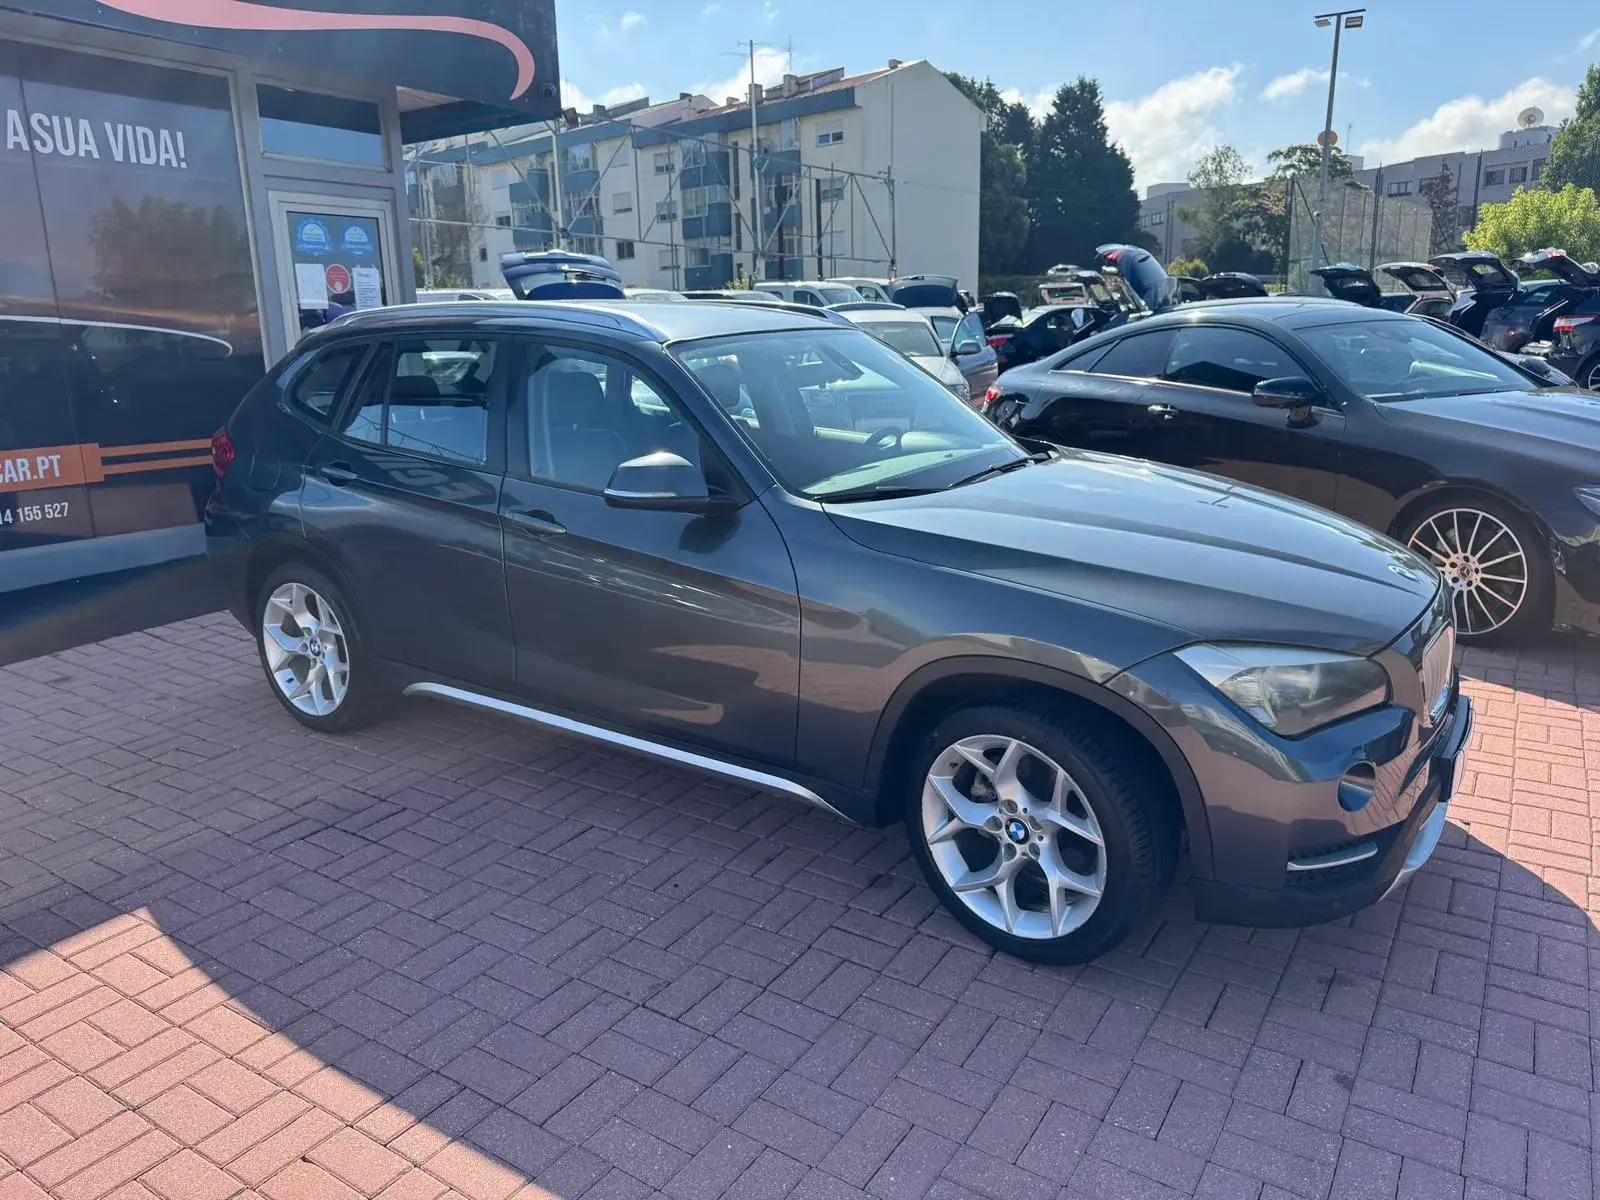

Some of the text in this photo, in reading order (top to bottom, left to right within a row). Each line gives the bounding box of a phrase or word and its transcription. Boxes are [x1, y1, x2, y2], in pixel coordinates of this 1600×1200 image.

[104, 121, 187, 168] VIDA!
[17, 506, 42, 523] 155
[45, 502, 69, 519] 527
